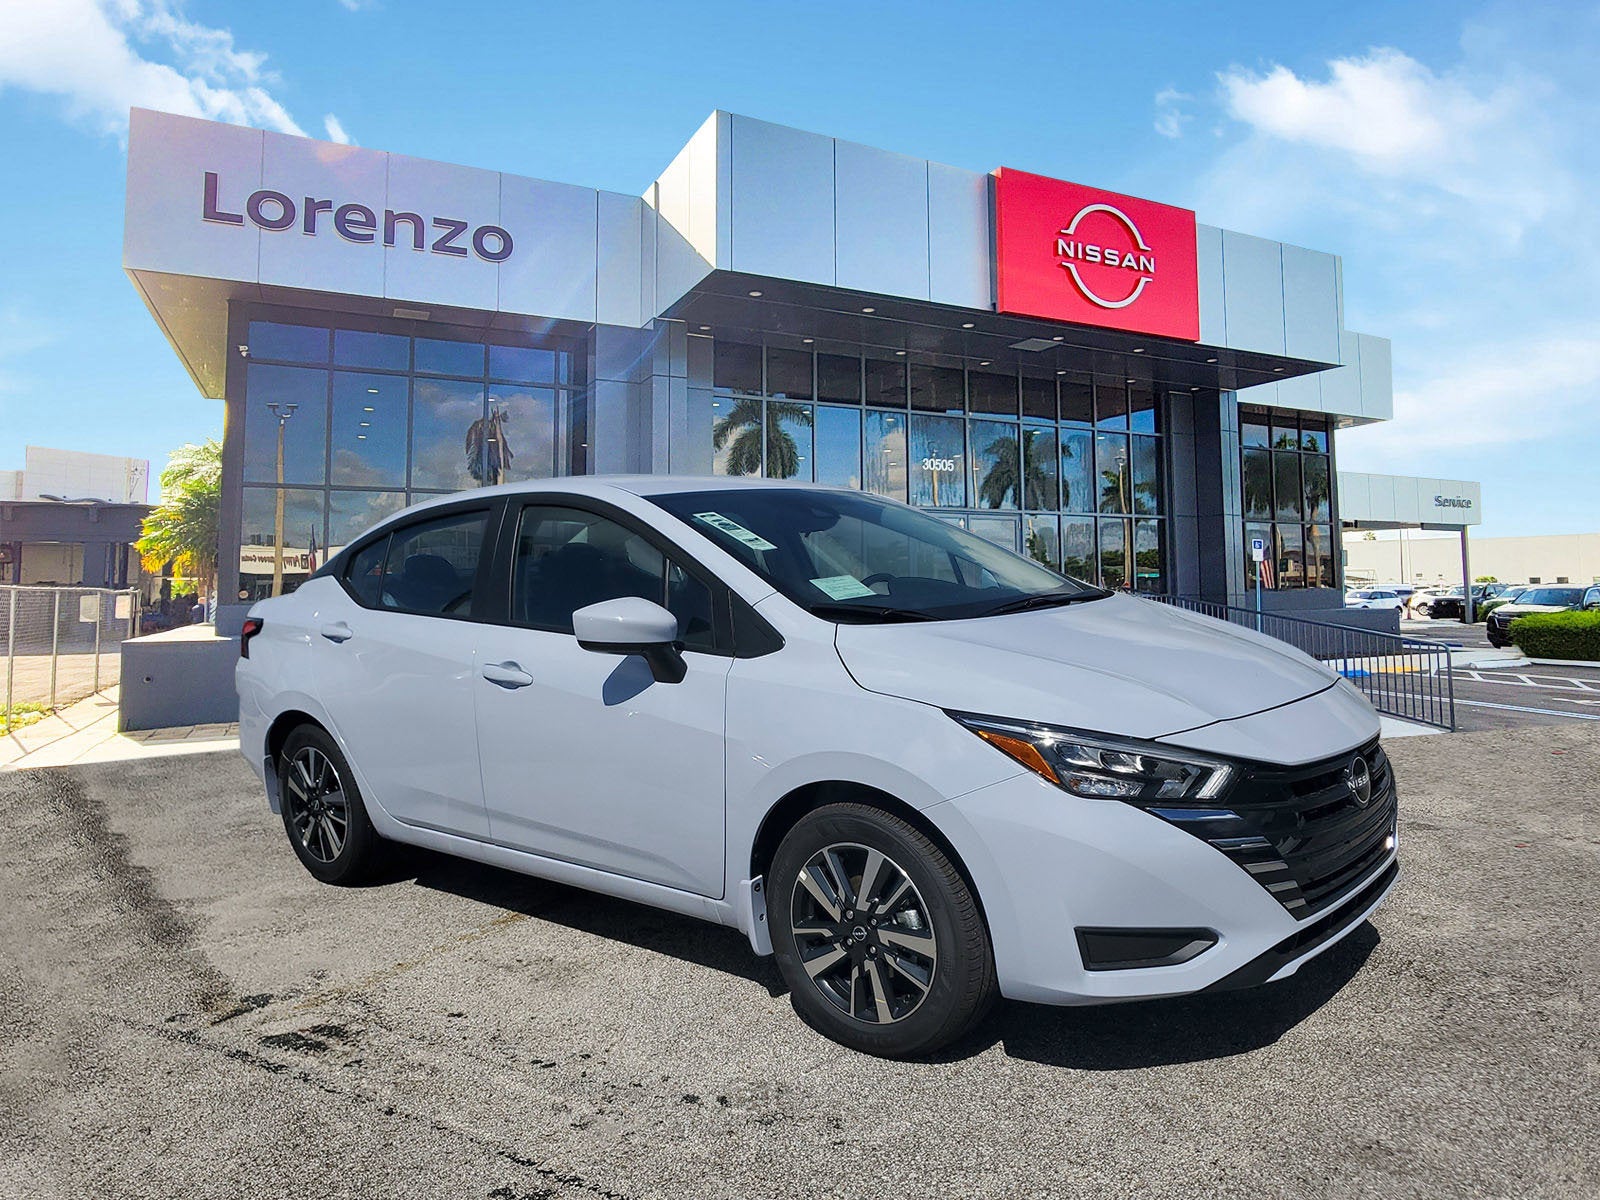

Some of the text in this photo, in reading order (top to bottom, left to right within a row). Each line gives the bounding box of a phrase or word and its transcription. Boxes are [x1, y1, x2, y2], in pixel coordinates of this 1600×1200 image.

[202, 171, 514, 262] Lorenzo
[1057, 238, 1155, 273] NISSAN
[922, 458, 954, 471] 30505
[1434, 495, 1472, 508] Service
